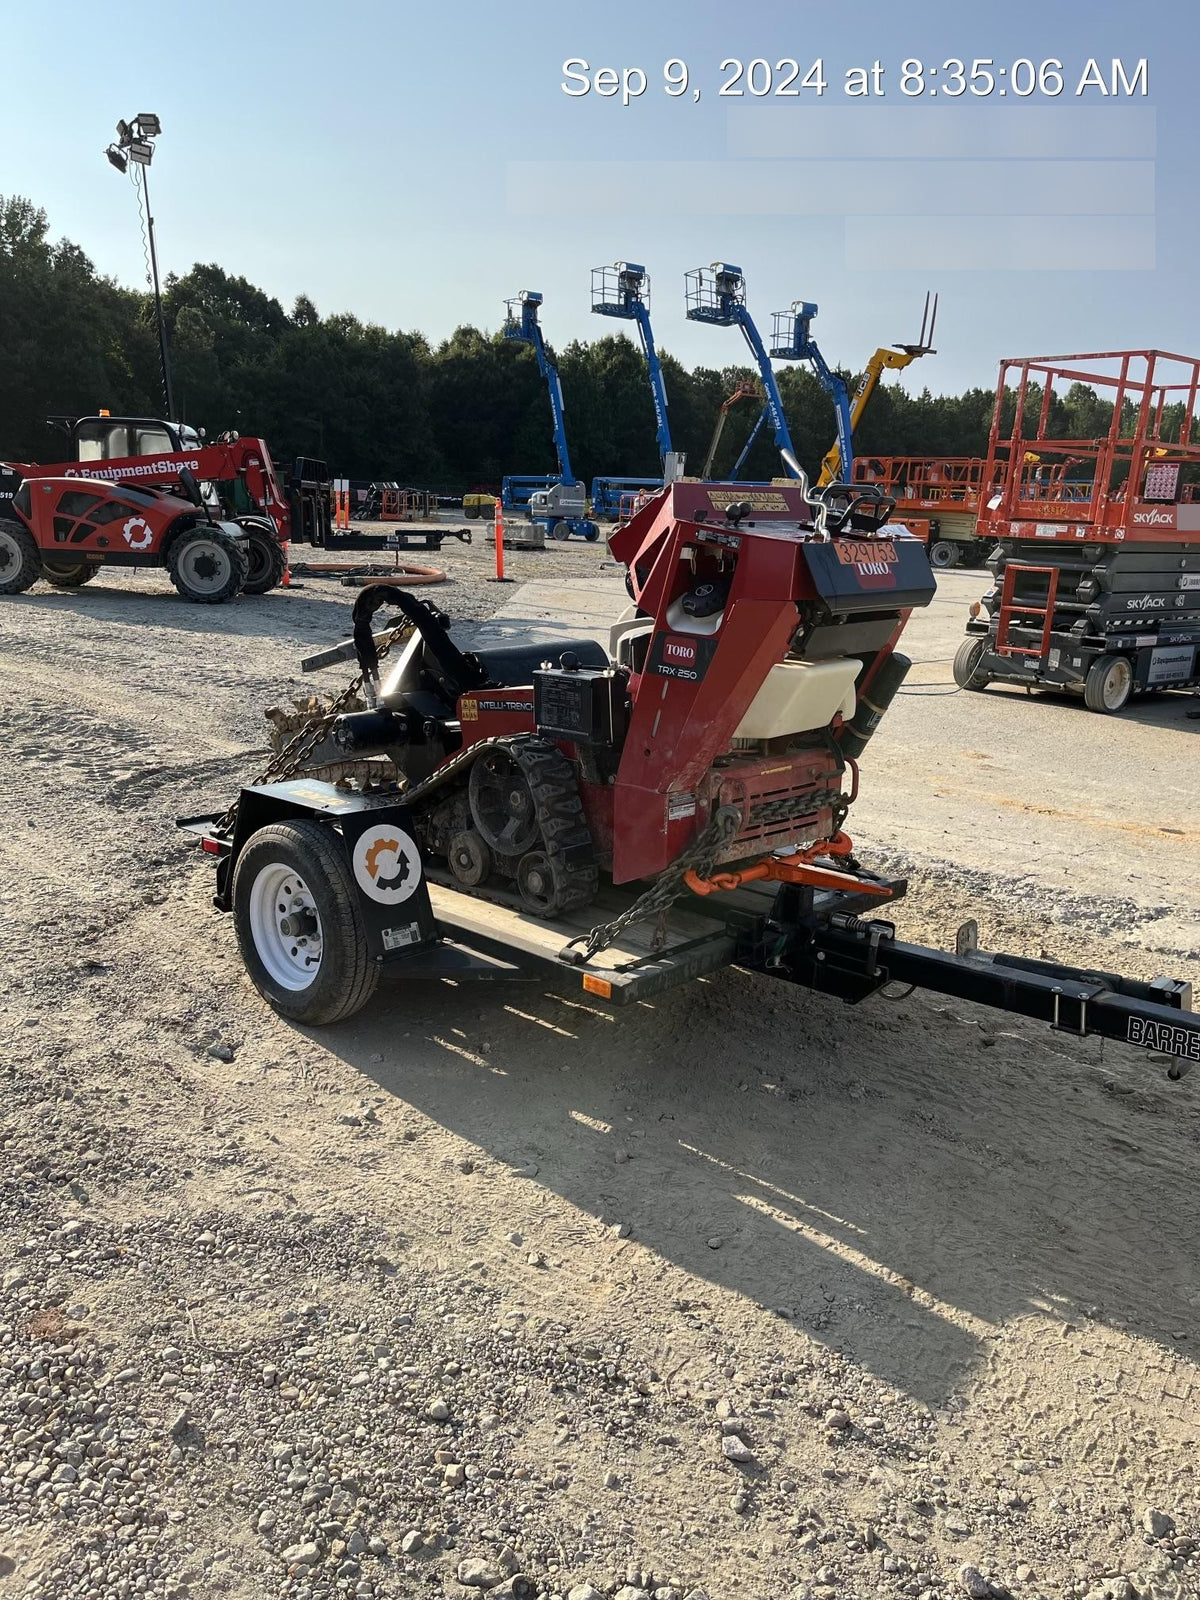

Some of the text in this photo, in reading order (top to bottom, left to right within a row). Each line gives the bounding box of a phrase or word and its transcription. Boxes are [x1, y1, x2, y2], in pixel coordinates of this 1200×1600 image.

[856, 372, 871, 397] JCB
[80, 460, 199, 481] EquipmentShare
[1133, 509, 1173, 525] SKYJACK
[839, 542, 897, 563] 329753
[1126, 594, 1166, 610] SKYJACK
[666, 643, 695, 659] TORO
[1127, 1015, 1200, 1061] BARRE
